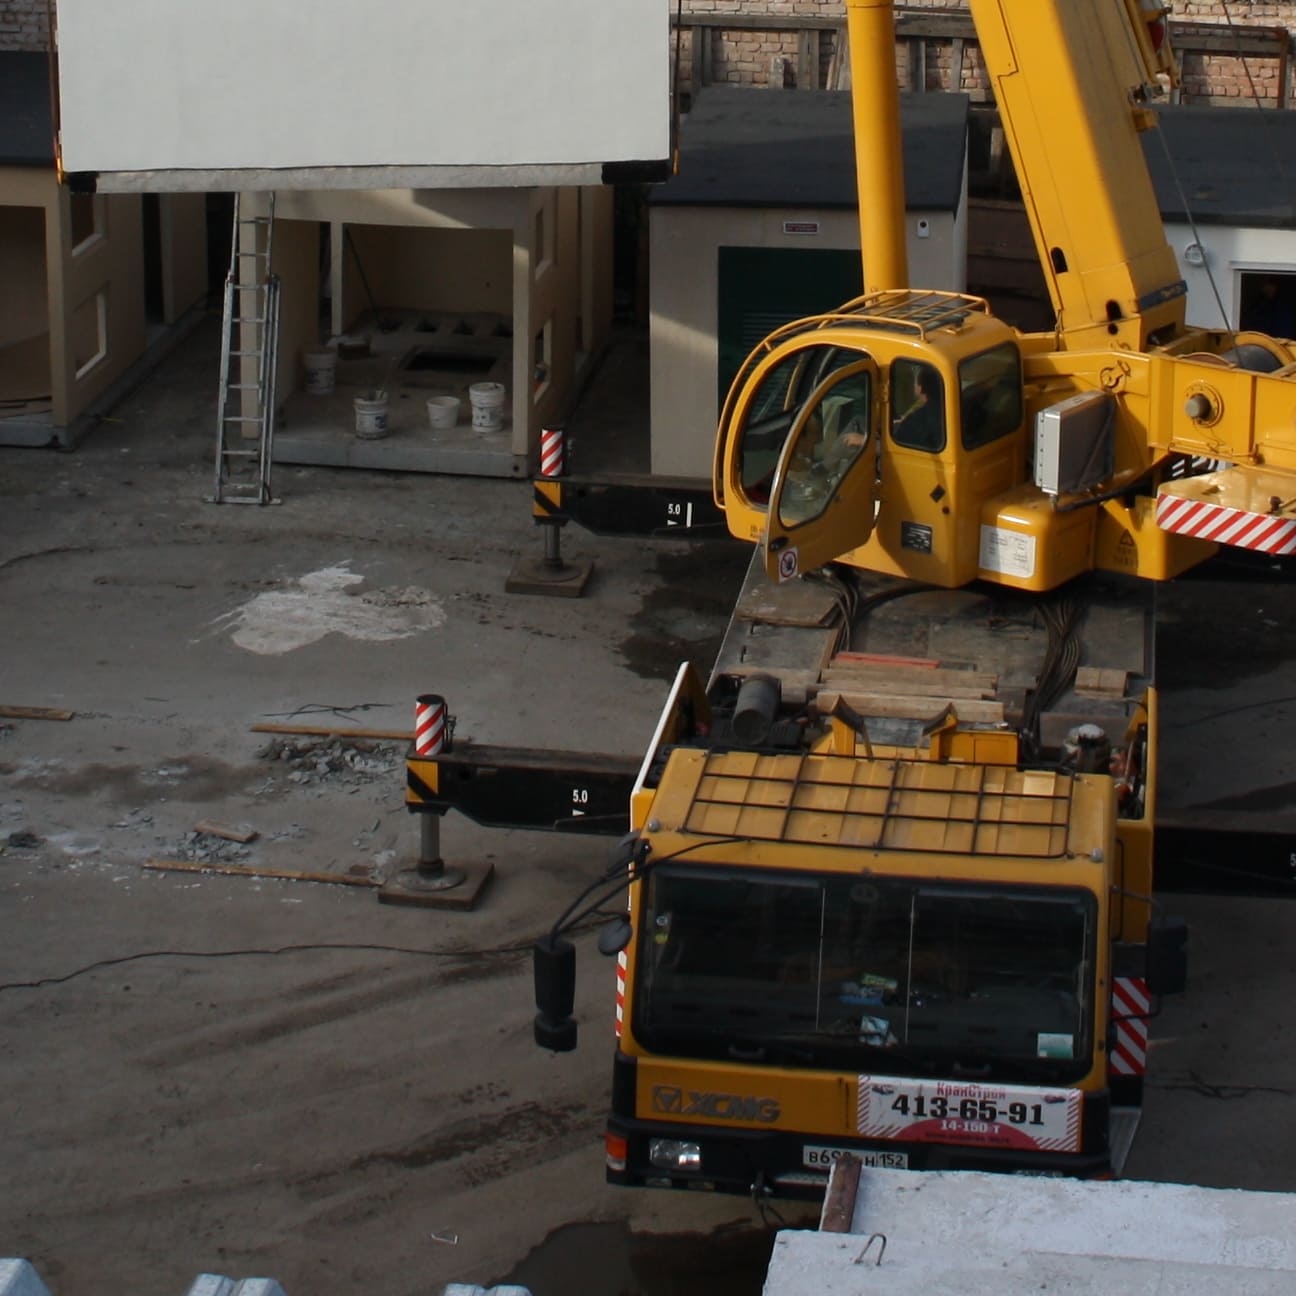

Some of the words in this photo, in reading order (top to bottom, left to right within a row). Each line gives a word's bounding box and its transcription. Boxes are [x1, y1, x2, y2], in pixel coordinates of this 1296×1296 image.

[667, 503, 681, 515] 5.0
[572, 788, 588, 803] 5.0
[682, 1090, 781, 1122] XCMG
[891, 1094, 1044, 1125] 413-65-91
